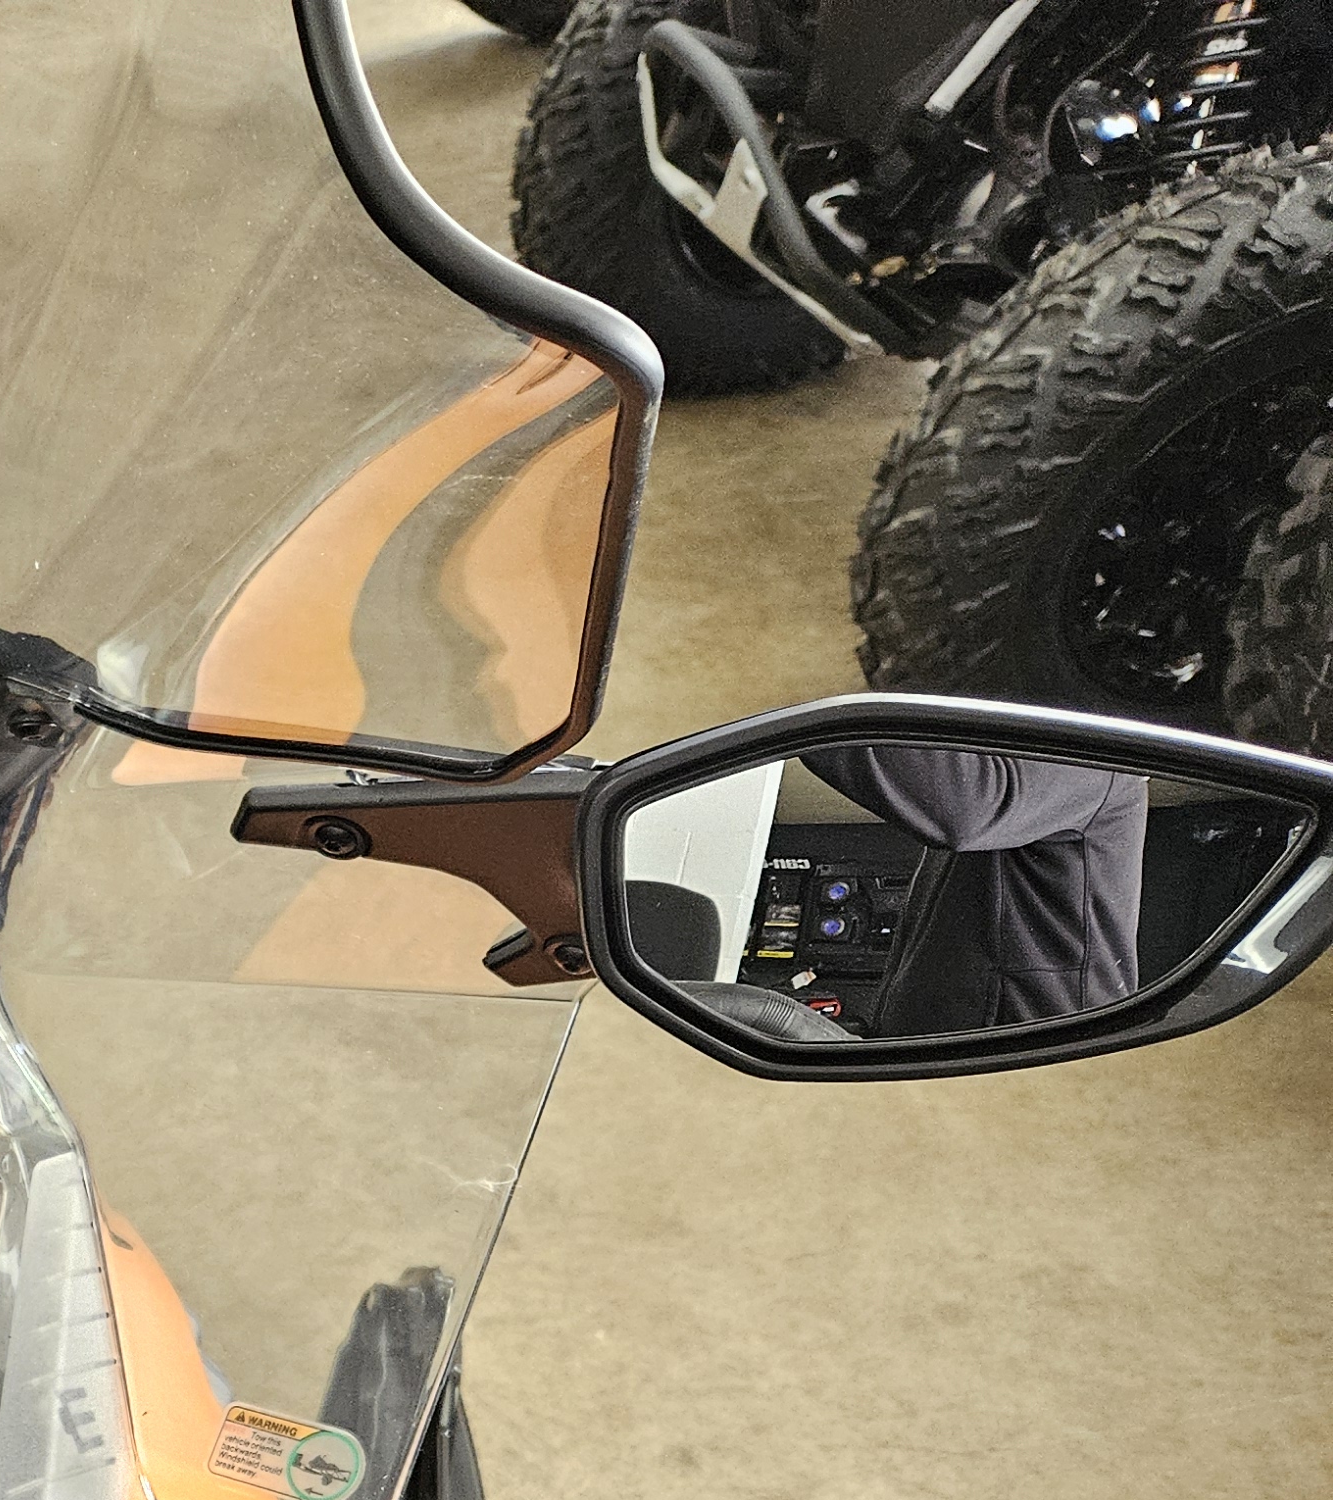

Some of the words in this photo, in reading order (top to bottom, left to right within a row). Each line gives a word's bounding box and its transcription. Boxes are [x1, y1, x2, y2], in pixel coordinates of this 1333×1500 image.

[248, 1413, 297, 1438] WARNING
[219, 1449, 259, 1469] Windshield
[260, 1461, 283, 1476] could
